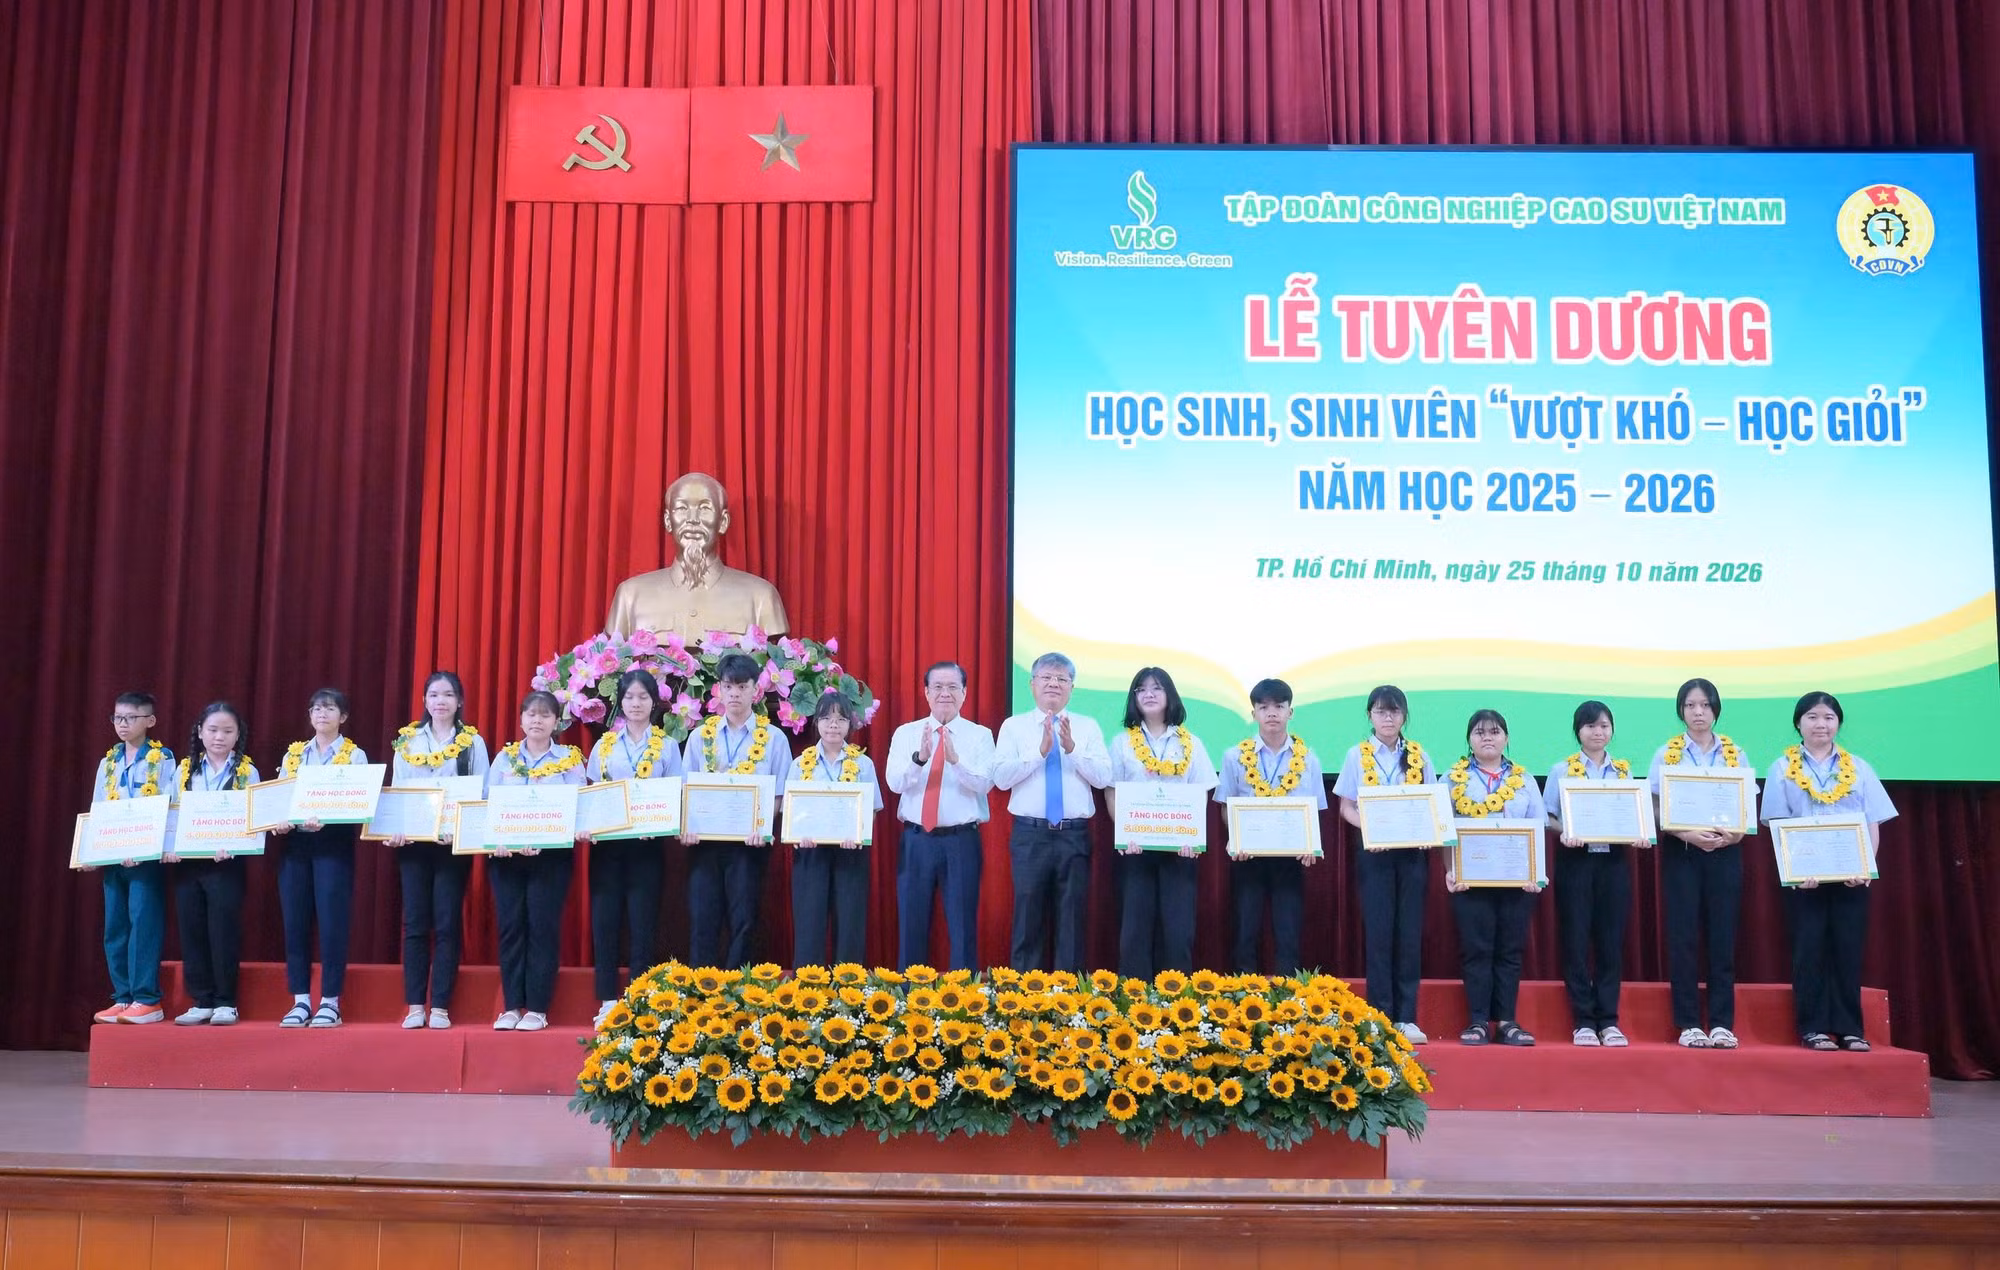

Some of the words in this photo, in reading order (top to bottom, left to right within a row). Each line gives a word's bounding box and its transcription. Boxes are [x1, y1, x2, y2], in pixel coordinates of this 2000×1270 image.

[1226, 193, 1277, 225] TẬP
[1284, 194, 1357, 221] ĐOÀN
[1365, 193, 1439, 222] CÔNG
[1446, 194, 1545, 227] NGHIỆP
[1552, 200, 1604, 222] CAO
[1612, 200, 1651, 222] SU
[1656, 195, 1714, 228] VIỆT
[1719, 200, 1784, 223] NAM
[1111, 226, 1176, 249] VRG
[1055, 252, 1105, 266] Vision.
[1107, 253, 1186, 267] Resilience.
[1188, 254, 1232, 268] Green
[1249, 276, 1317, 359] LỄ
[1337, 287, 1532, 360] TUYÊN
[1555, 295, 1768, 361] DƯƠNG
[1090, 395, 1164, 445] HỌC
[1177, 396, 1277, 443] SINH,
[1290, 398, 1379, 438] SINH
[1391, 389, 1476, 439] VIÊN
[1616, 391, 1691, 441] KHÓ
[1738, 400, 1814, 451] HỌC
[1299, 460, 1385, 511] NĂM
[1399, 470, 1474, 521] HỌC
[1486, 472, 1577, 513] 2025
[1624, 473, 1716, 514] 2026
[1255, 557, 1285, 579] TP.
[1292, 555, 1324, 579] Hồ
[1329, 557, 1369, 579] Chí
[1373, 558, 1437, 583] Minh,
[1444, 559, 1501, 583] ngày
[1505, 560, 1536, 581] 25
[1542, 560, 1607, 585] tháng
[1616, 561, 1642, 582] 10
[1648, 561, 1699, 583] năm
[1705, 562, 1763, 584] 2026
